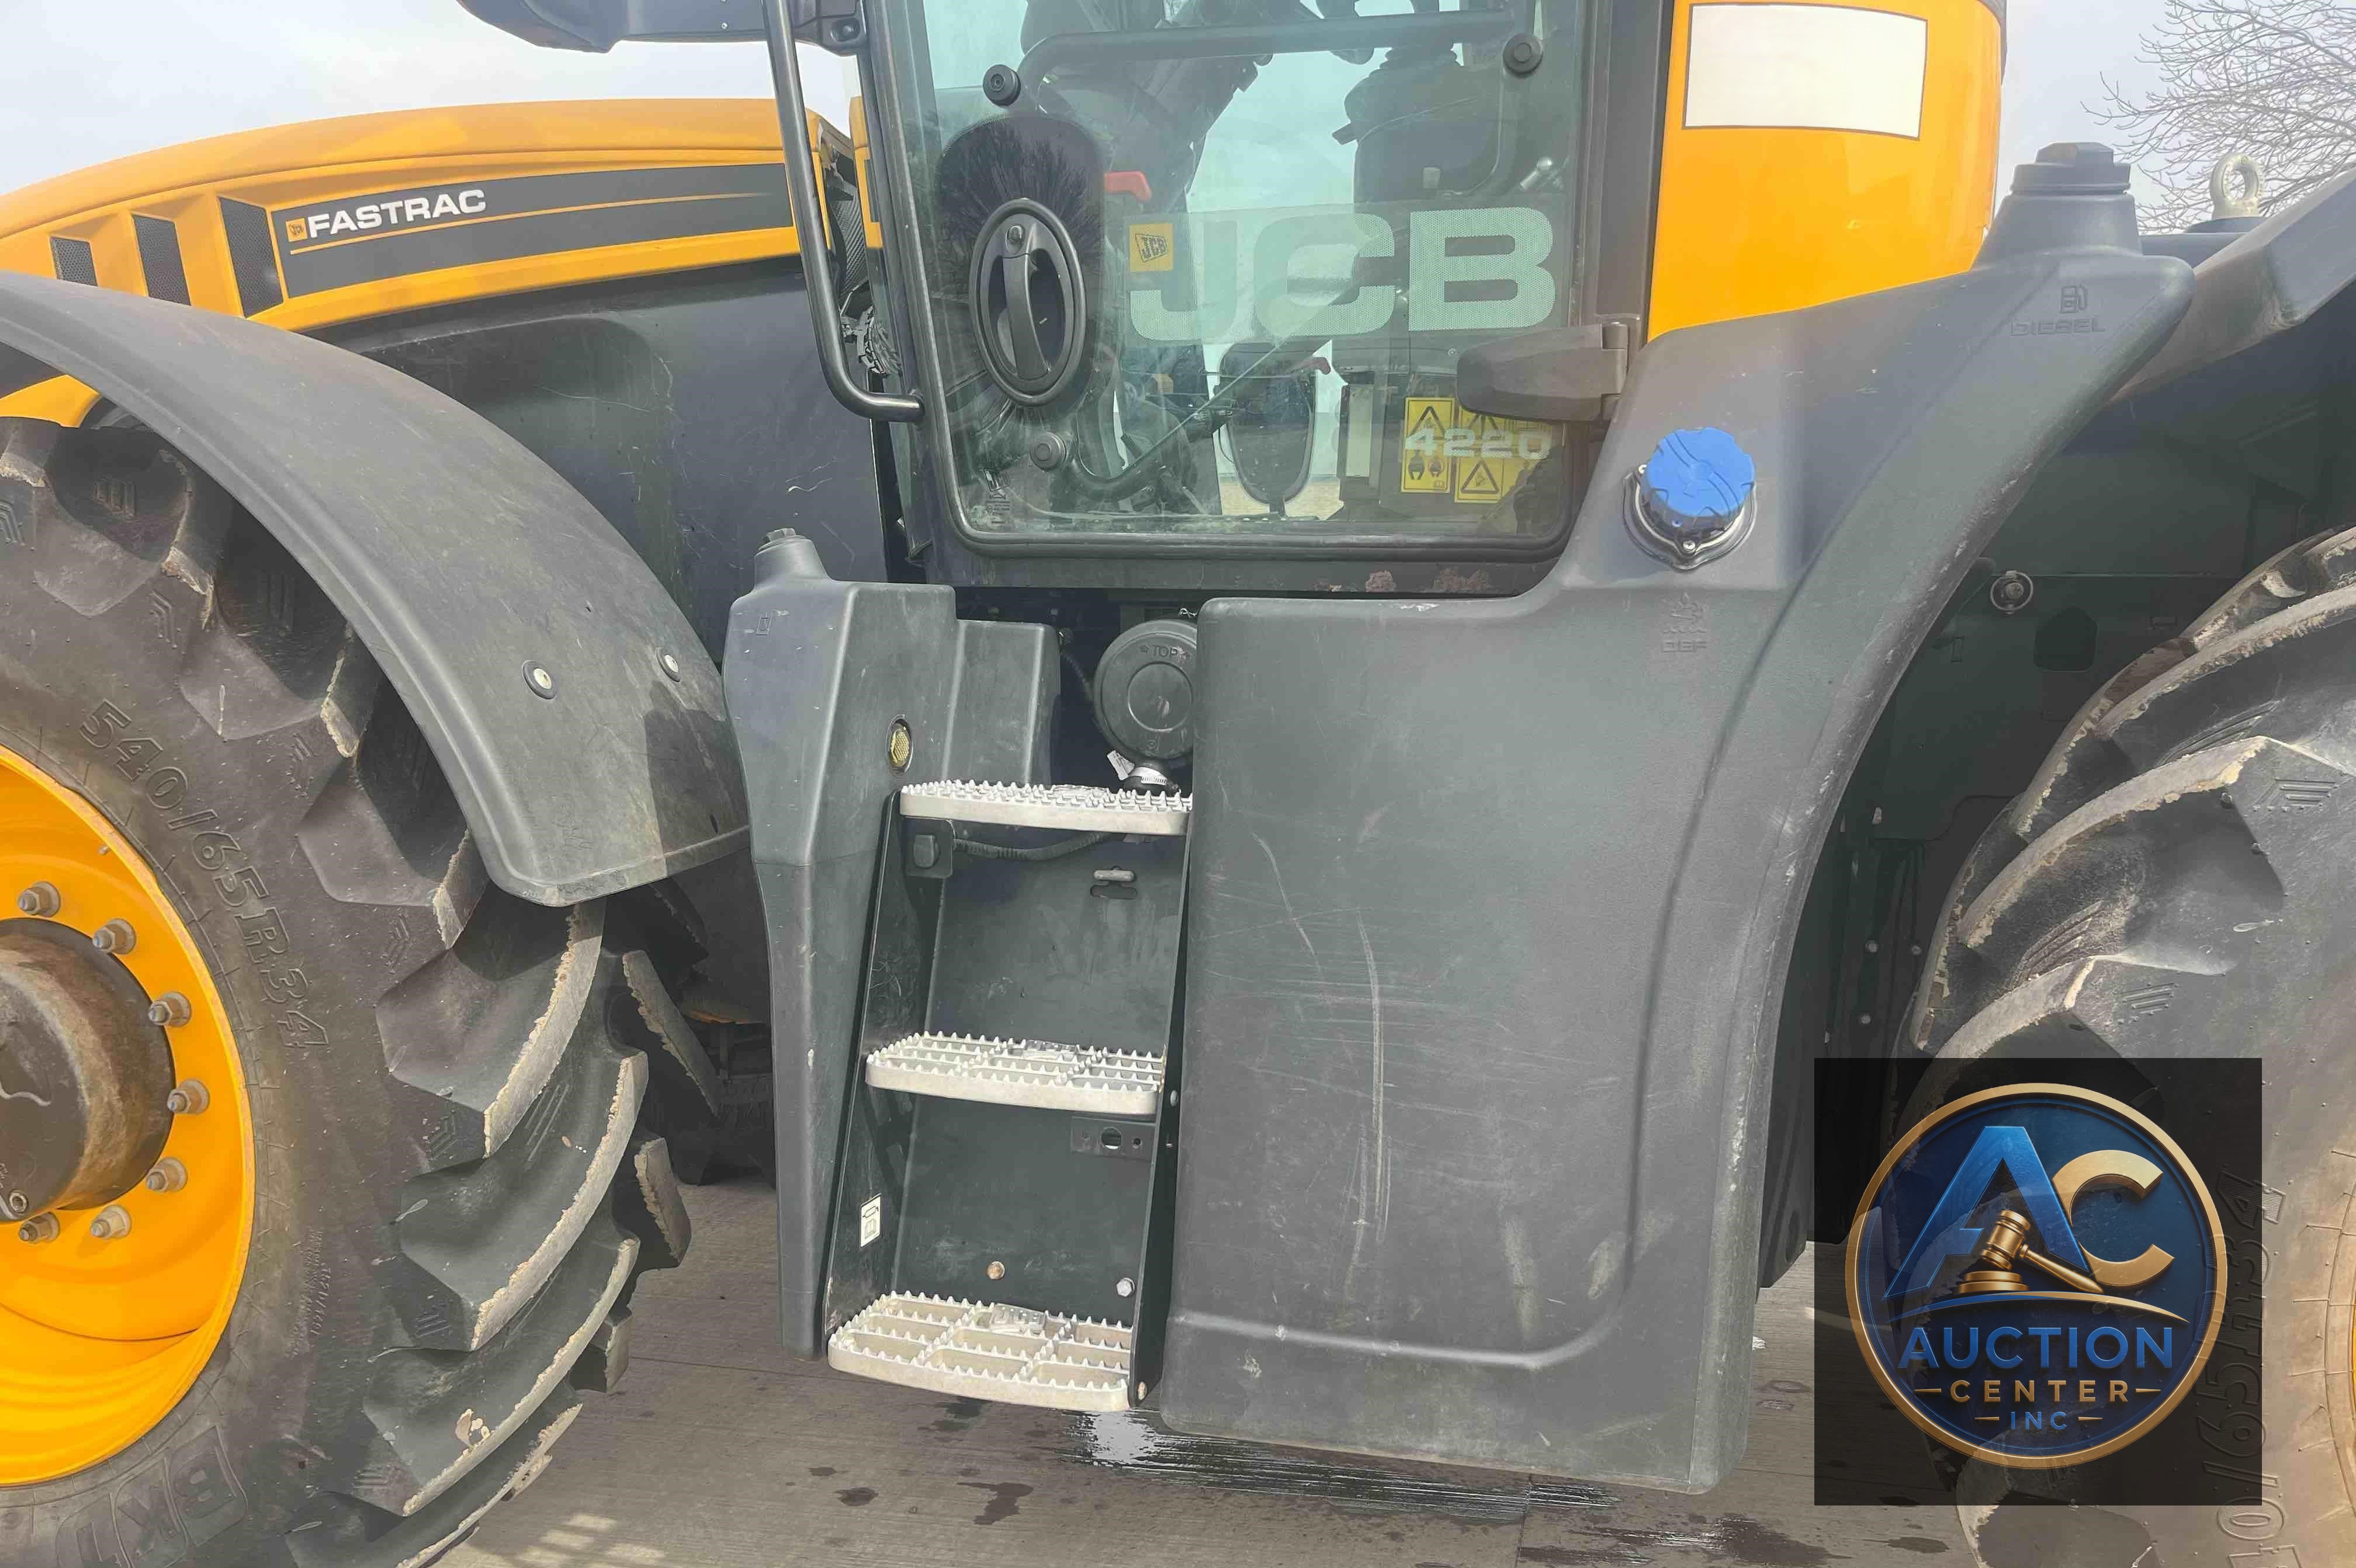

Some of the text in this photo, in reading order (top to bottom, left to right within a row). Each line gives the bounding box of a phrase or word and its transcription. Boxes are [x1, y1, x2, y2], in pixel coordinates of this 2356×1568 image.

[307, 189, 486, 239] FASTRAC
[1136, 234, 1167, 262] JCB
[1130, 206, 1555, 341] JCB
[2009, 317, 2105, 337] DIESEL
[1405, 428, 1552, 460] 4220
